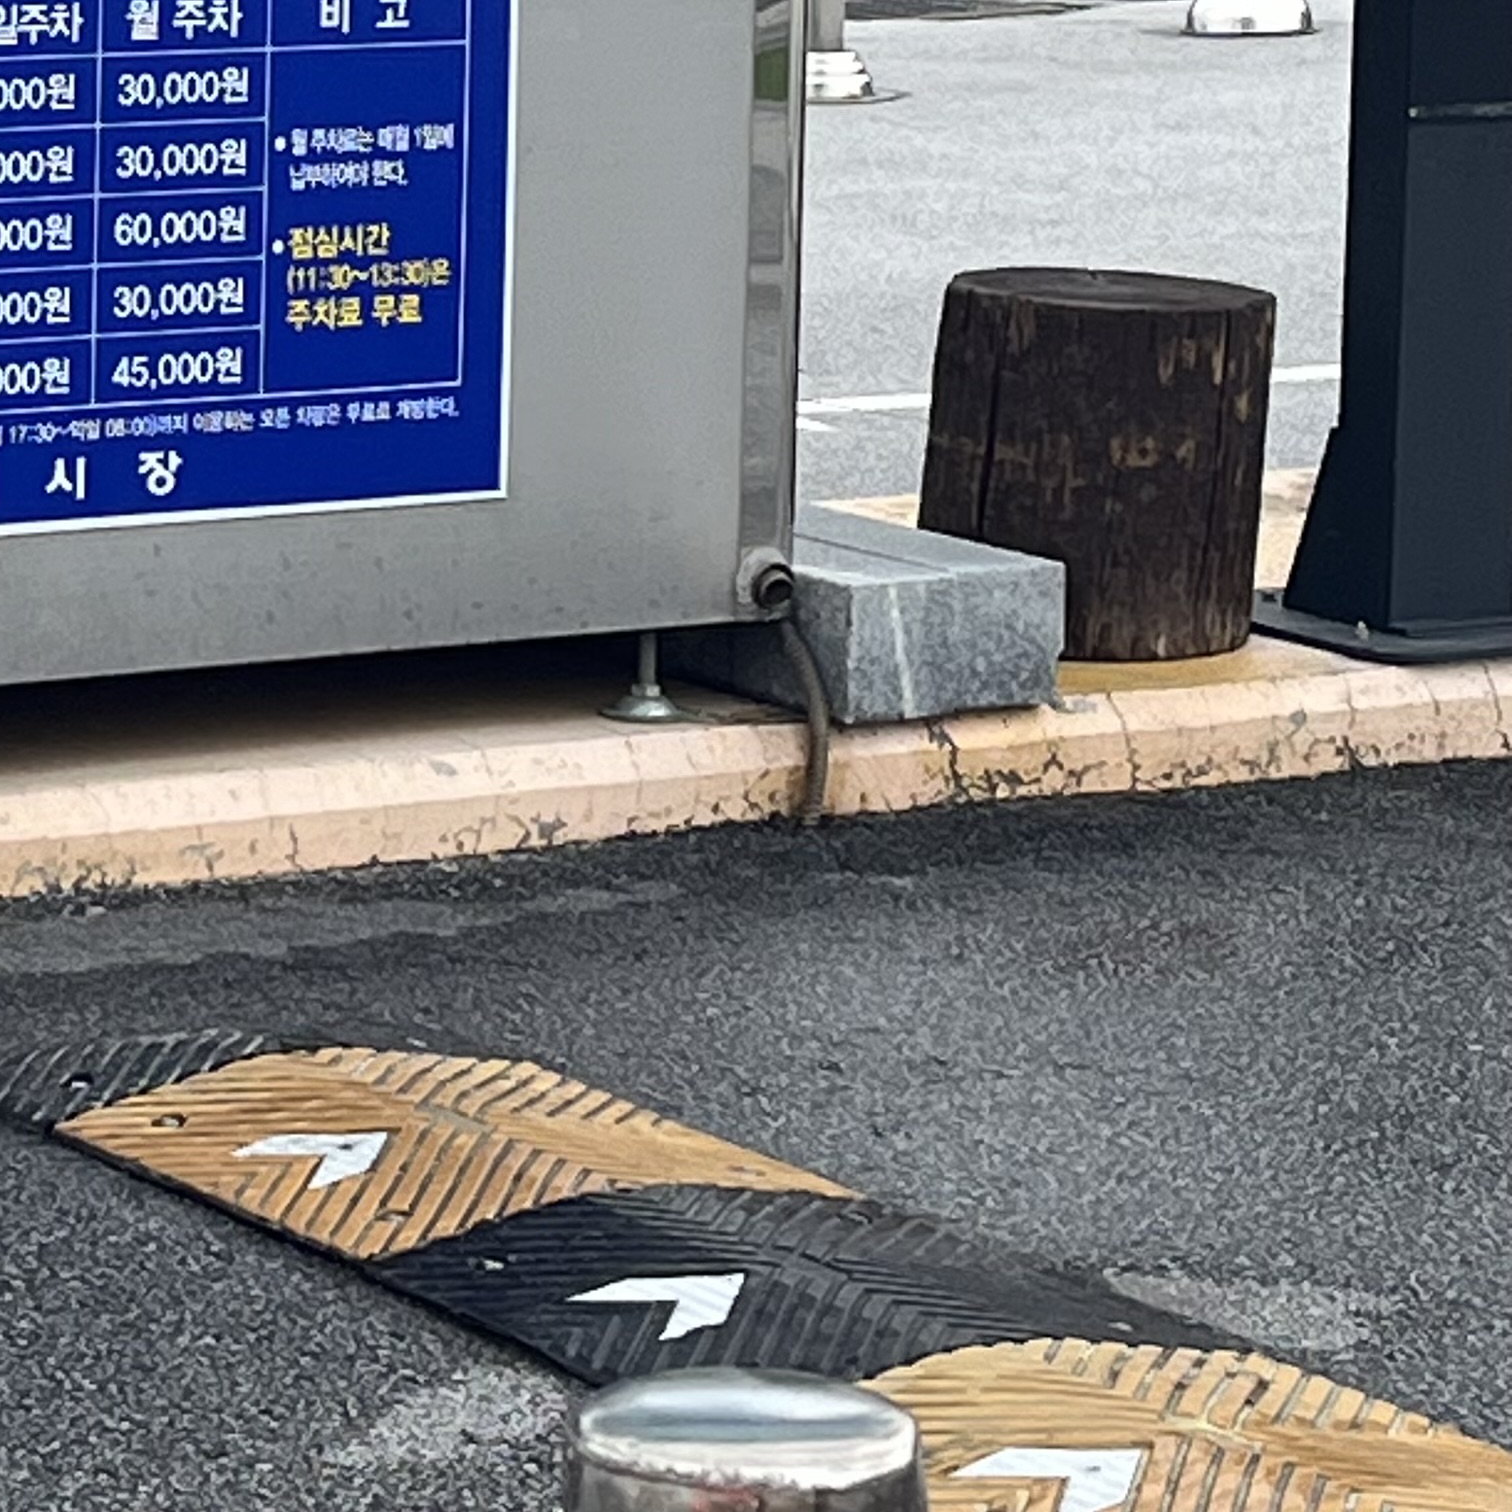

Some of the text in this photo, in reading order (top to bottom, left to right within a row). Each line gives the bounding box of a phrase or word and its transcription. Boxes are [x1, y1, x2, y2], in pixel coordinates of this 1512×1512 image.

[117, 67, 249, 109] 30,000원
[115, 138, 247, 181] 30,000원
[114, 205, 246, 248] 60,000원
[288, 222, 391, 260] 점심시간
[113, 277, 244, 320] 30,000원
[285, 293, 423, 332] 주차료 무료
[111, 347, 243, 390] 45,000원
